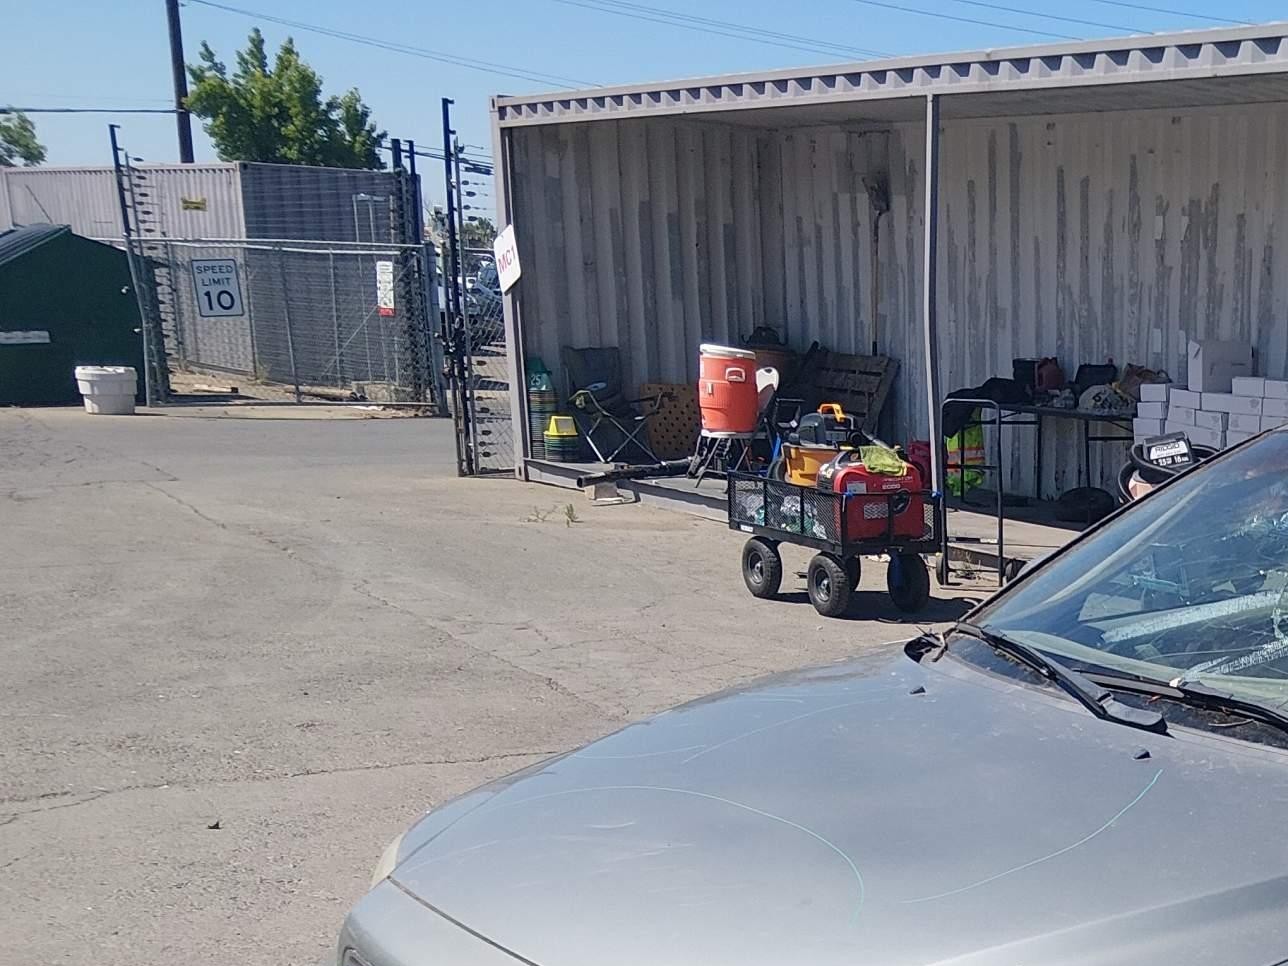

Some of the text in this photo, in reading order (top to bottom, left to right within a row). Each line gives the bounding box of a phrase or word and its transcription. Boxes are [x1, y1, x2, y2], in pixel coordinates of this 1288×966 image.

[498, 245, 516, 273] MC1
[196, 265, 233, 274] SPEED
[202, 277, 231, 287] LIMIT
[204, 290, 235, 311] 10
